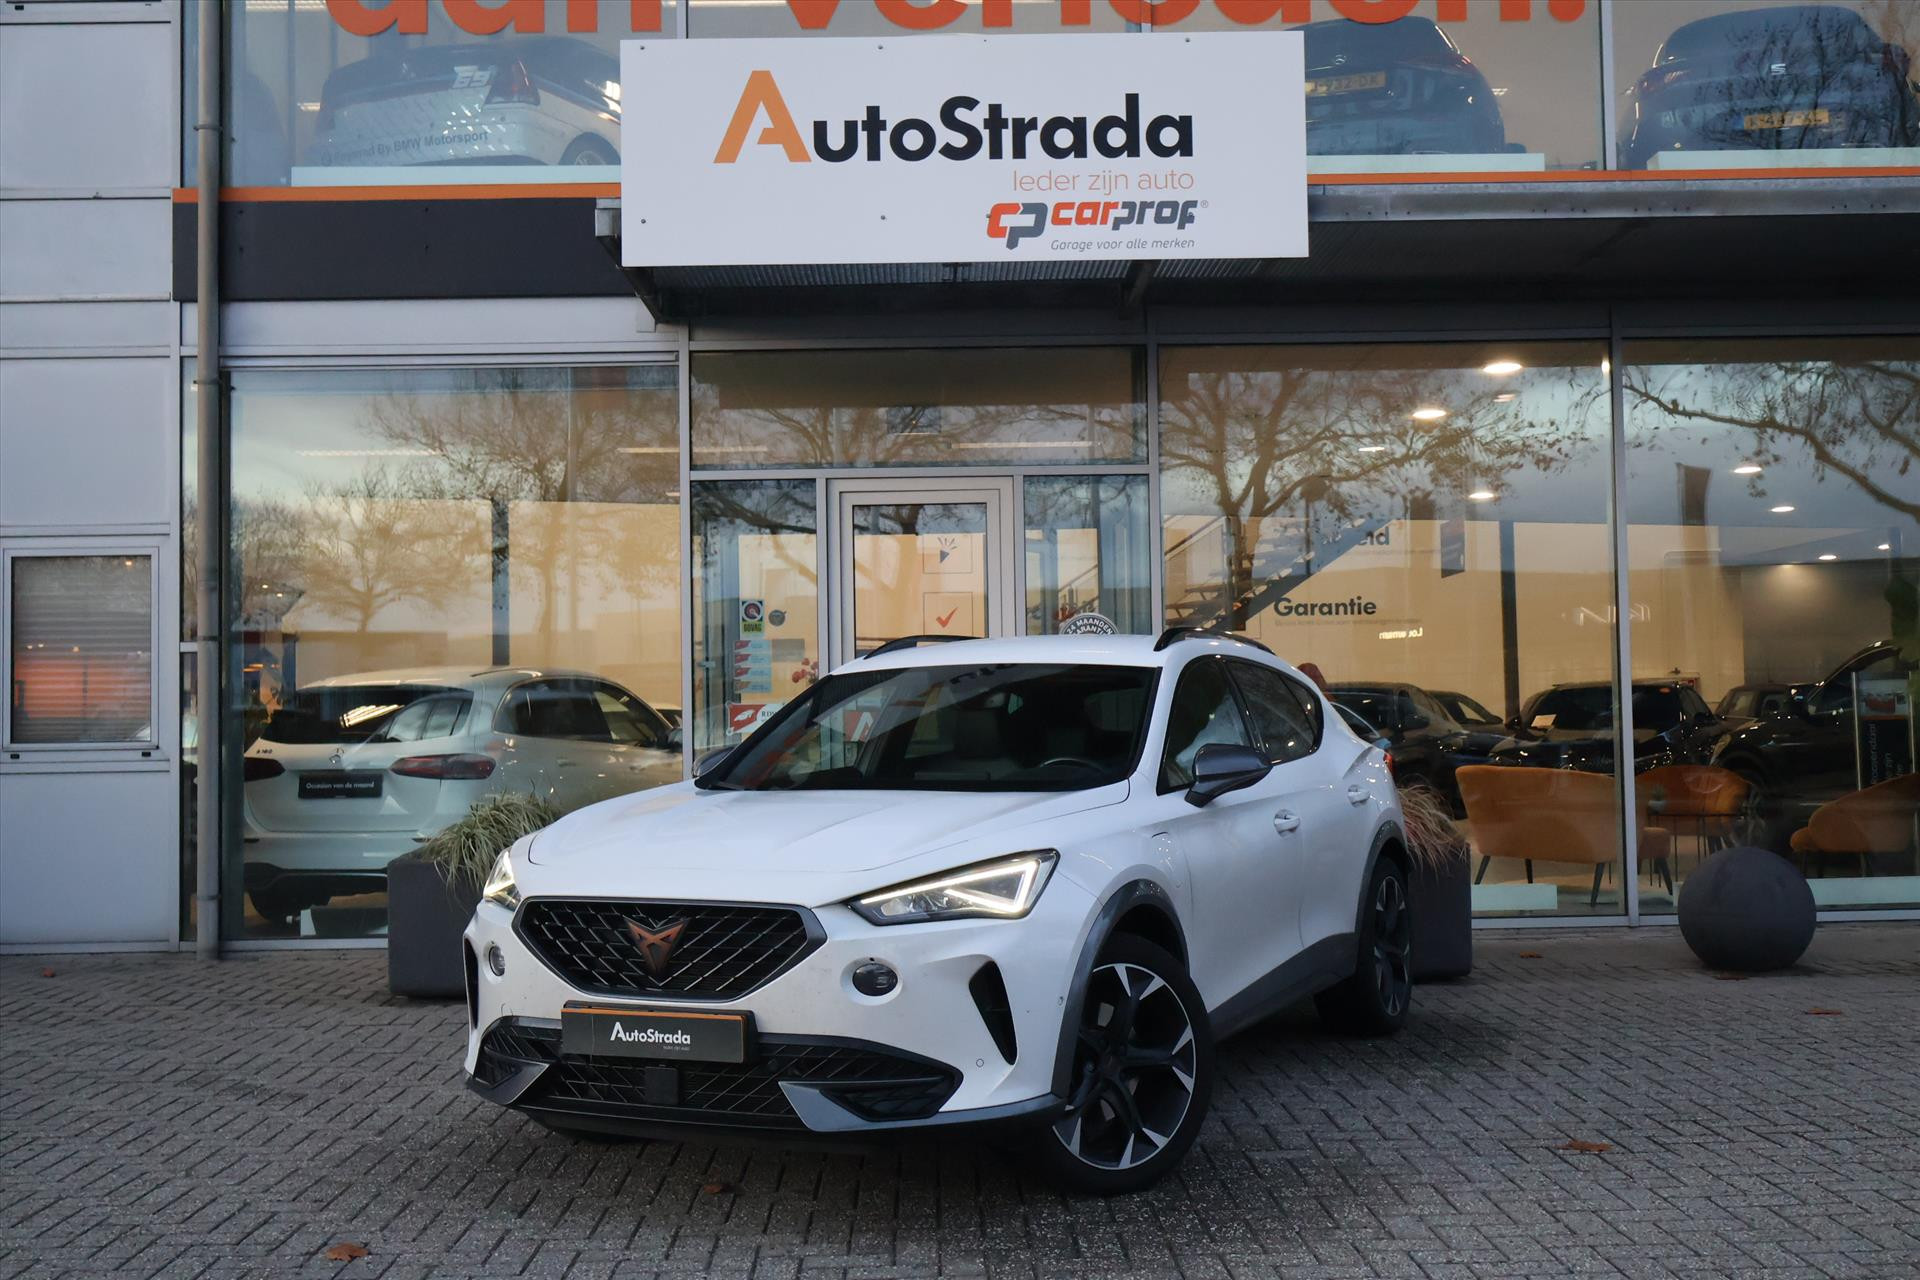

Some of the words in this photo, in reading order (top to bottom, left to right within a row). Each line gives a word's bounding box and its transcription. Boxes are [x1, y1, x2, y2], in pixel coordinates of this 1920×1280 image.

[713, 70, 1194, 164] AutoStrada
[377, 142, 392, 155] By
[394, 137, 421, 152] BMW
[424, 132, 488, 147] Motorsport
[1013, 170, 1080, 191] Ieder
[1088, 170, 1128, 195] zijn
[1138, 169, 1194, 190] auto
[1051, 239, 1092, 252] Garage
[1097, 240, 1122, 249] voor
[1127, 238, 1148, 249] alle
[1151, 238, 1195, 249] merken
[1274, 596, 1377, 616] Garantie
[1067, 624, 1076, 634] 24
[1076, 618, 1113, 635] MAANDEN
[344, 781, 352, 789] de
[354, 781, 375, 789] maand
[610, 1021, 691, 1045] AutoStrada
